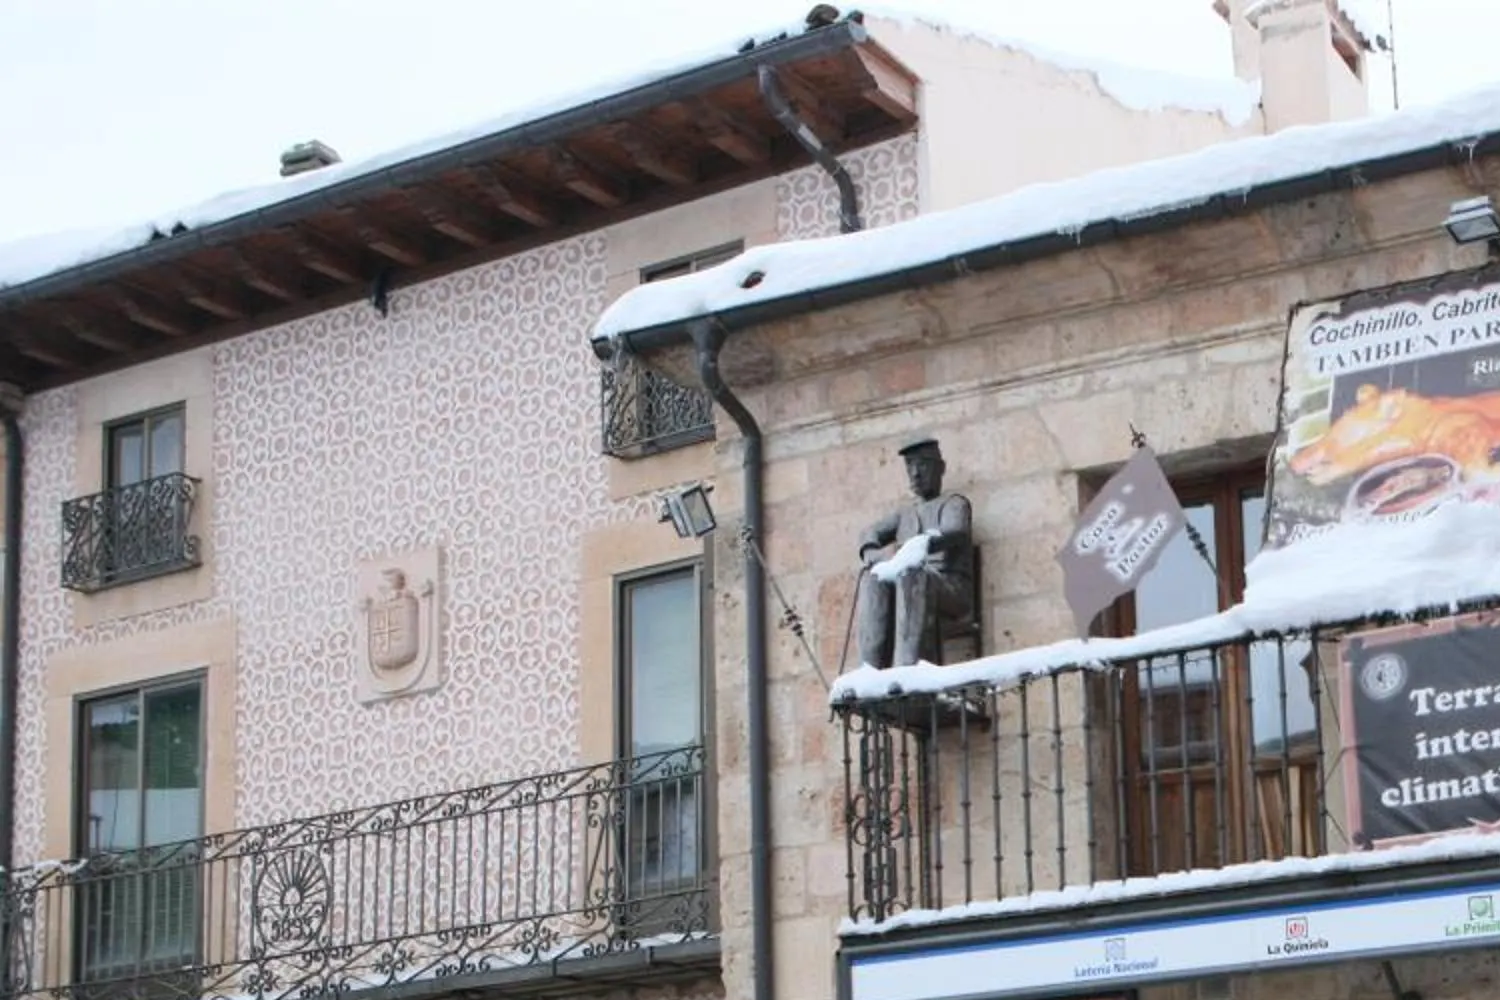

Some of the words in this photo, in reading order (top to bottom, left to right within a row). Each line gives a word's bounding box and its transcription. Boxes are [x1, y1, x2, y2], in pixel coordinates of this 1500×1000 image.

[1080, 507, 1117, 550] Casa
[1117, 520, 1164, 575] Pastor
[1446, 925, 1459, 937] La
[1267, 944, 1281, 955] La
